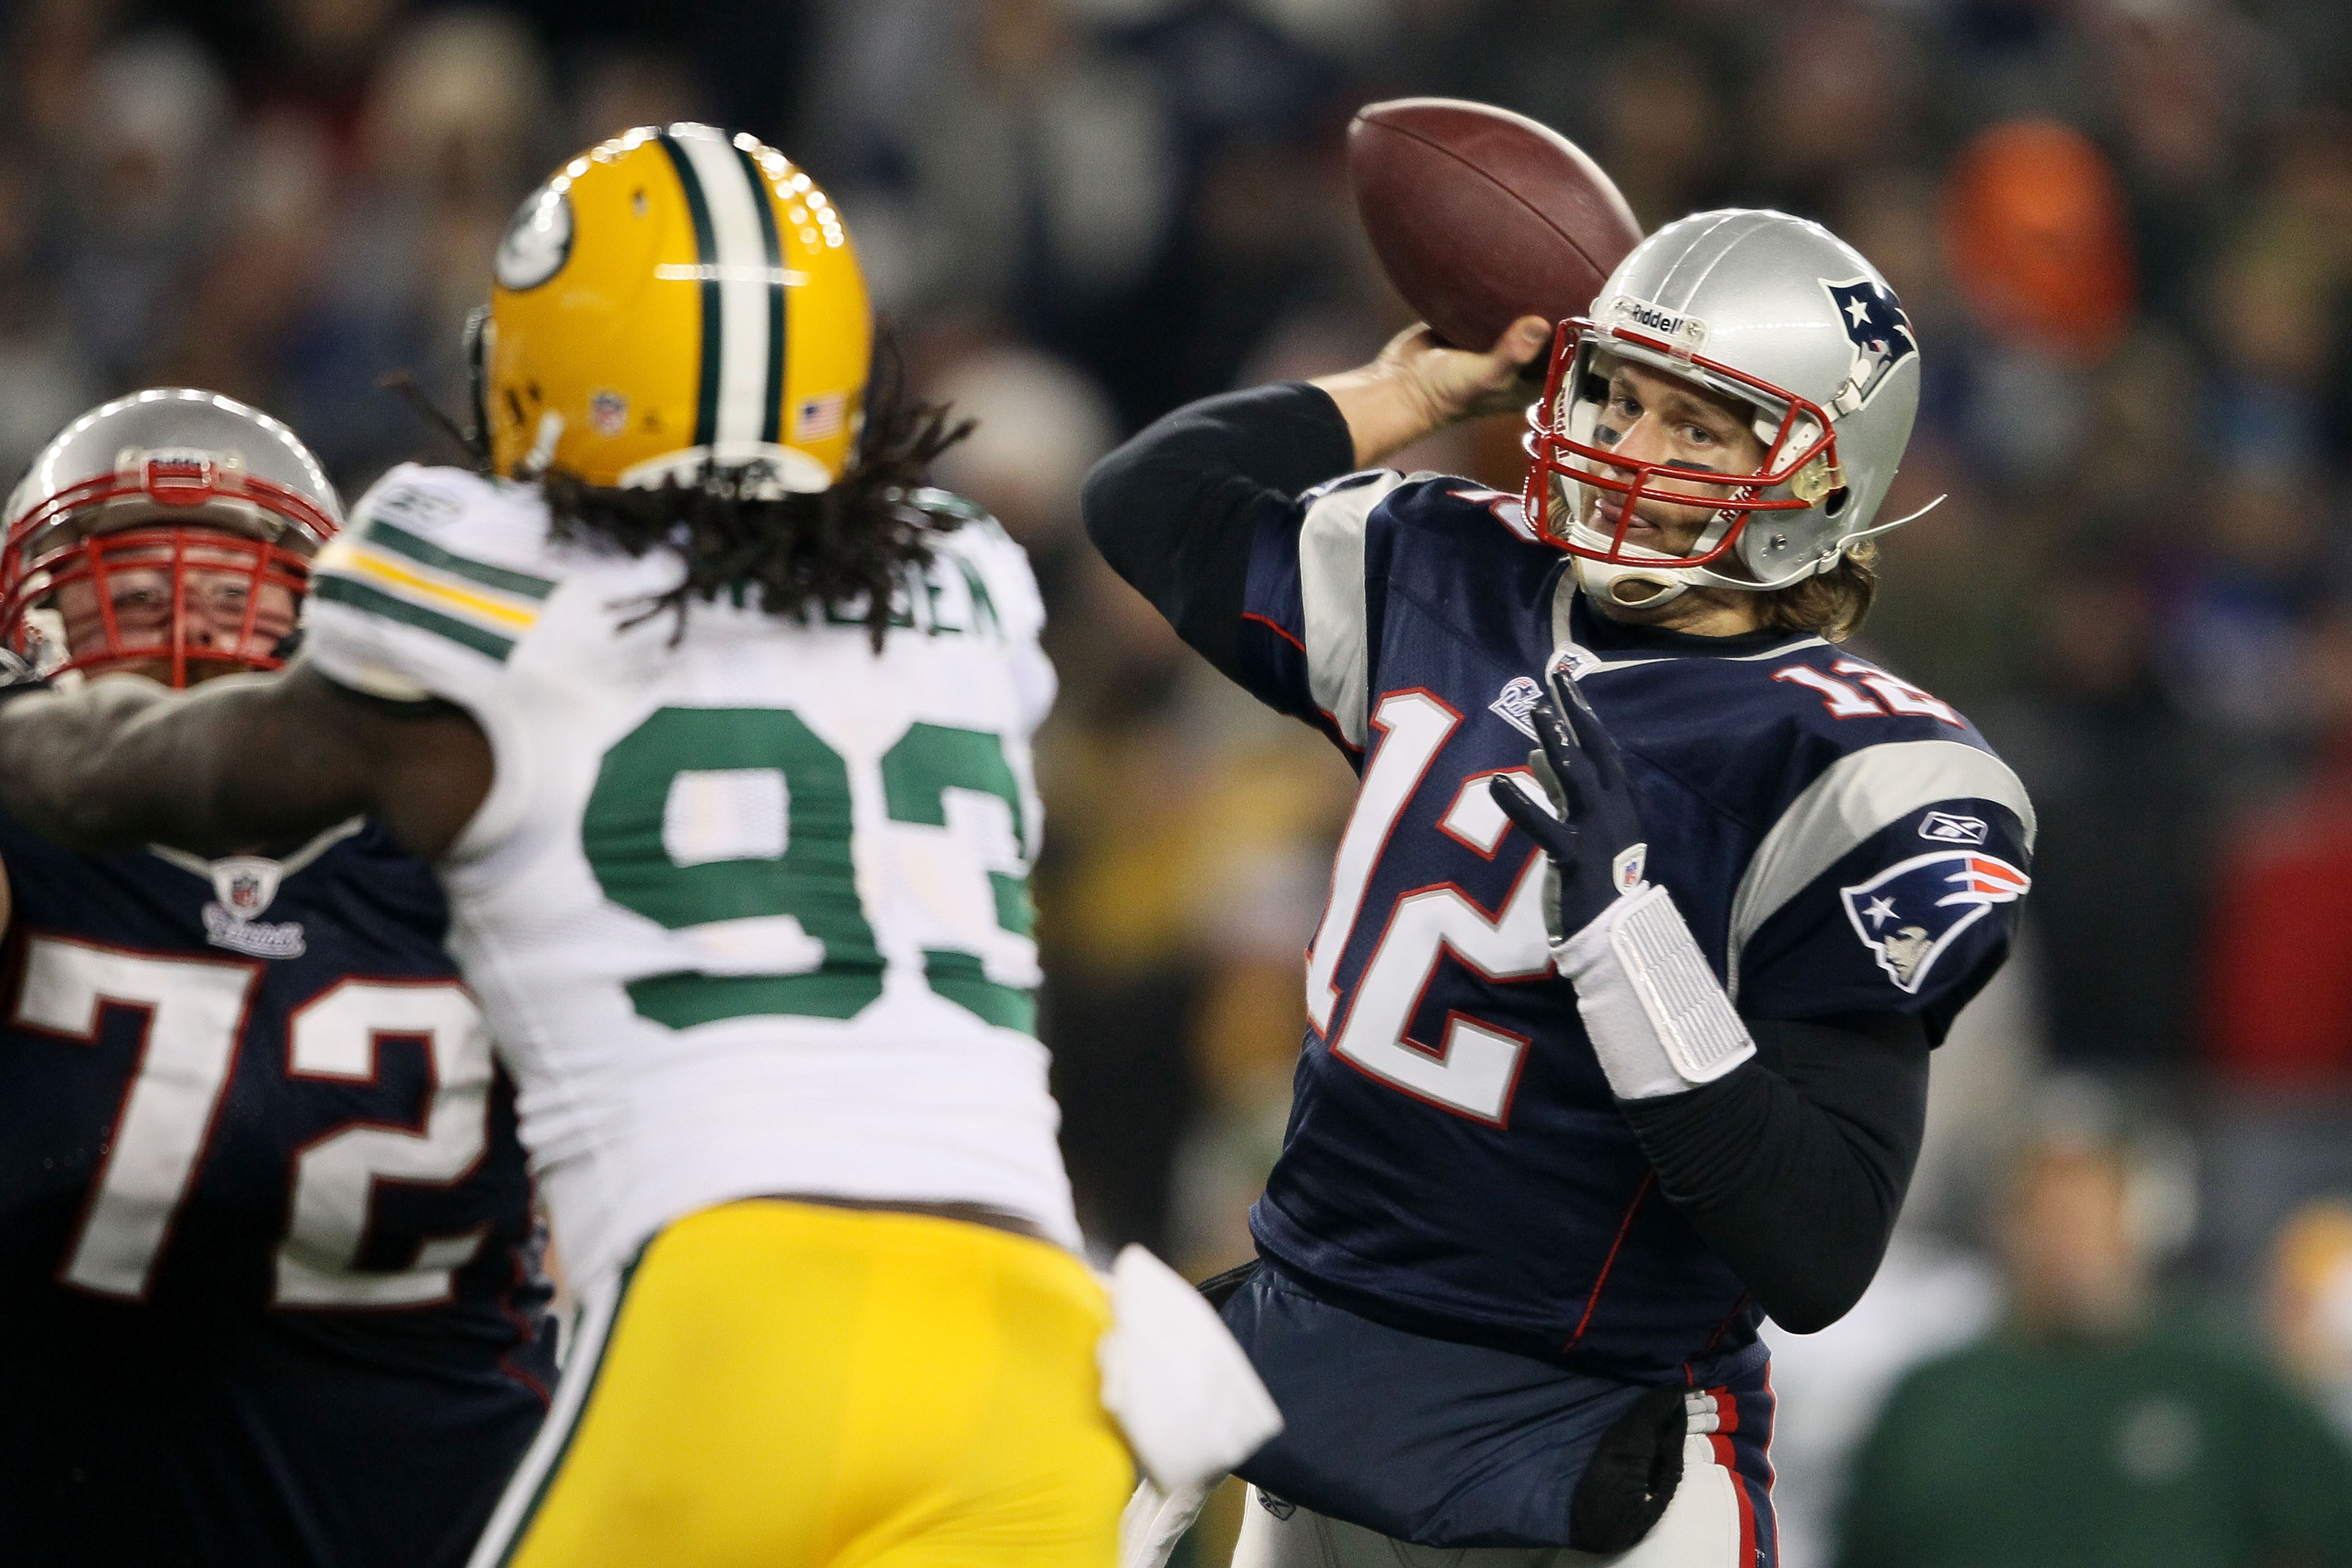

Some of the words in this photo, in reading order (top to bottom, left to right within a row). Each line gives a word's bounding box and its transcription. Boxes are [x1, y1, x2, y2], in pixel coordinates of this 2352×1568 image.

[582, 706, 1036, 1036] 93
[1770, 659, 1966, 729] 12
[1305, 686, 1558, 1130] 12
[8, 930, 492, 1309] 72
